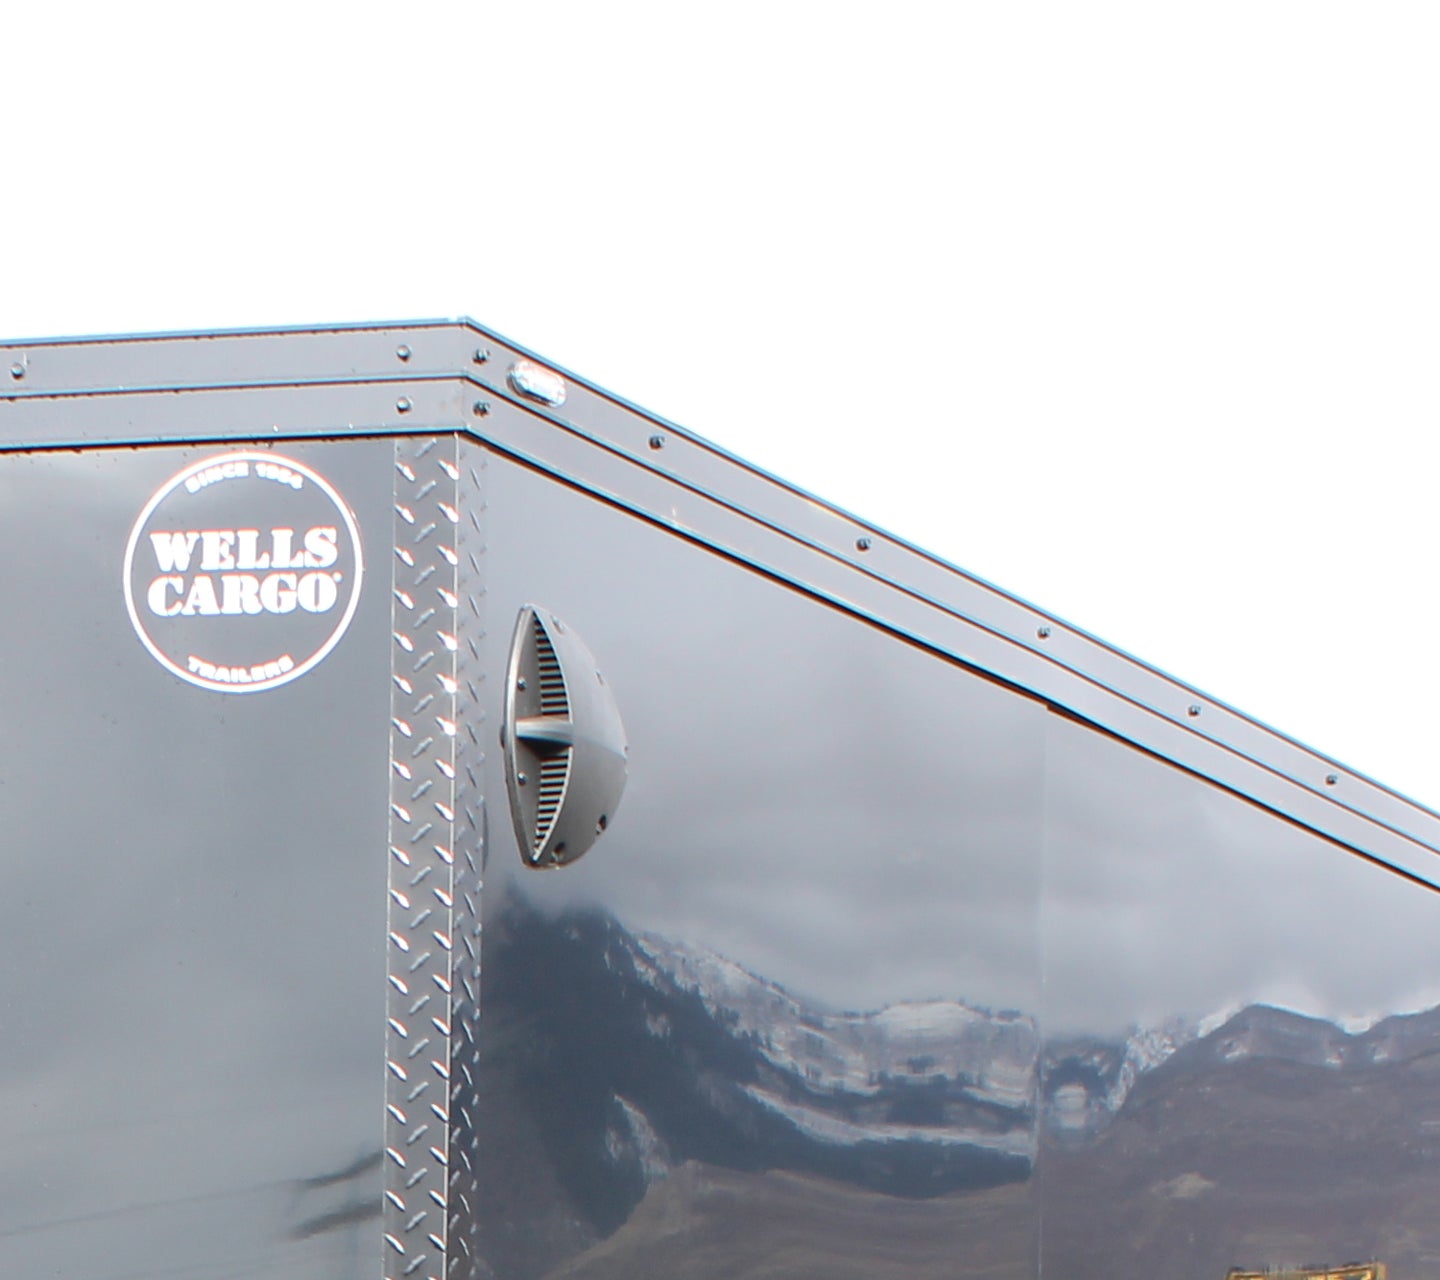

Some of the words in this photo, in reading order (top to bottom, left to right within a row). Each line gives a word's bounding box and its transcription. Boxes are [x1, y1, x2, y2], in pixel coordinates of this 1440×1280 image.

[149, 526, 338, 572] WELLS
[146, 573, 338, 617] CARGO
[187, 653, 295, 683] TRAILERS
